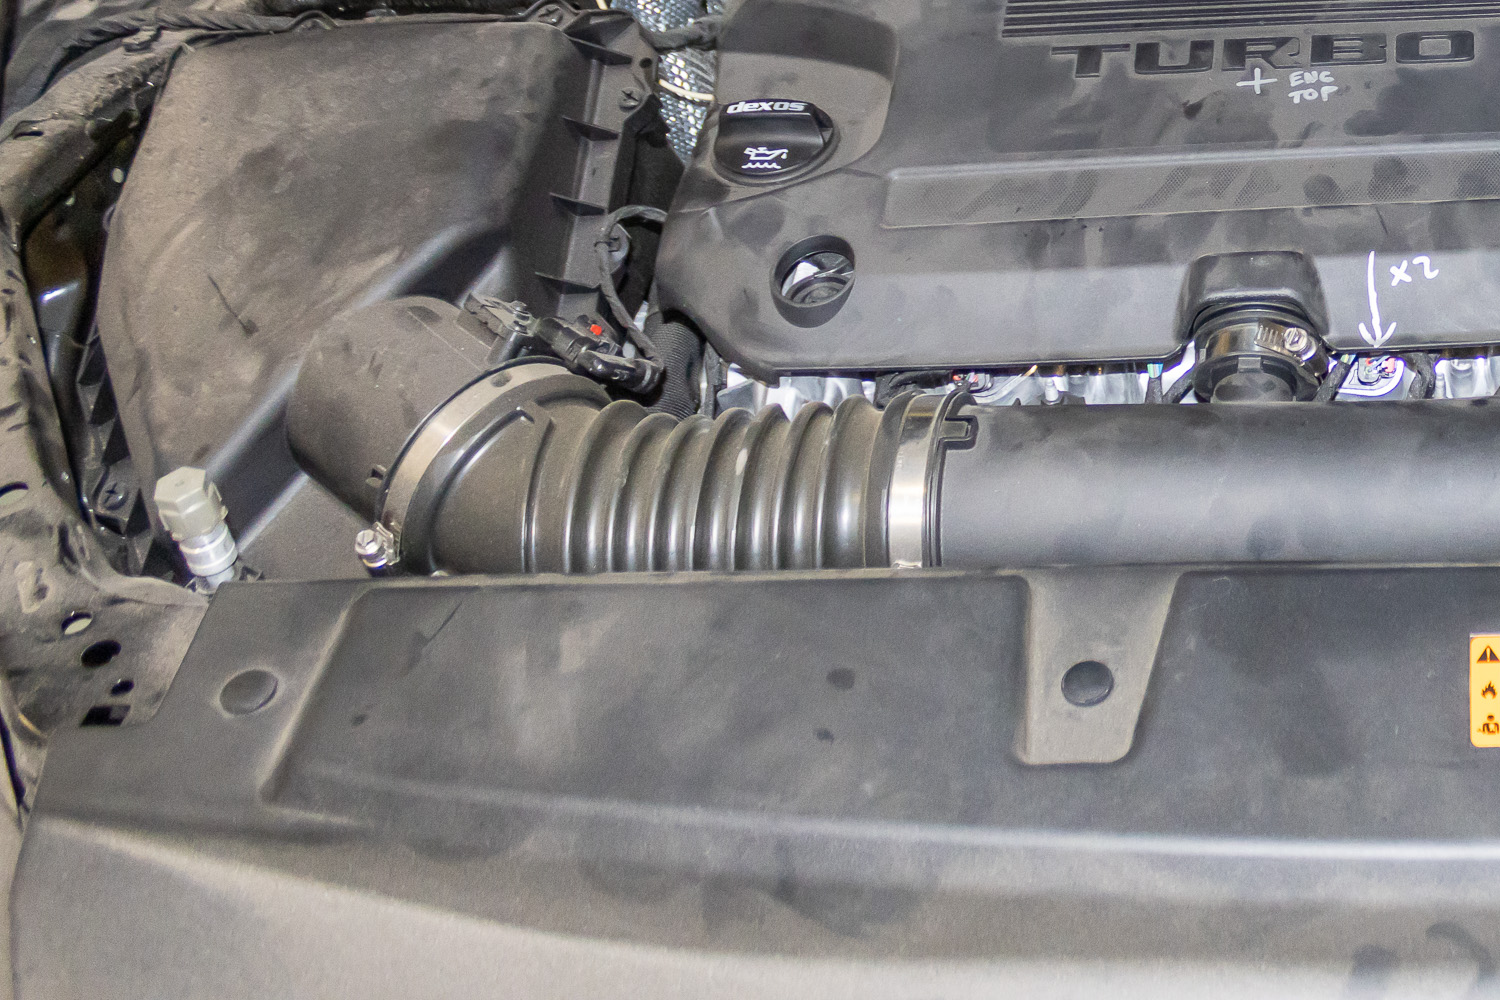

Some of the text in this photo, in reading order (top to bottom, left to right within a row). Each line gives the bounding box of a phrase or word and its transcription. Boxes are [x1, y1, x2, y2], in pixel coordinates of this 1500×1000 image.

[1051, 31, 1475, 79] TURBO
[1288, 70, 1336, 88] ENG
[1287, 85, 1339, 104] TOP
[726, 101, 809, 114] dexos
